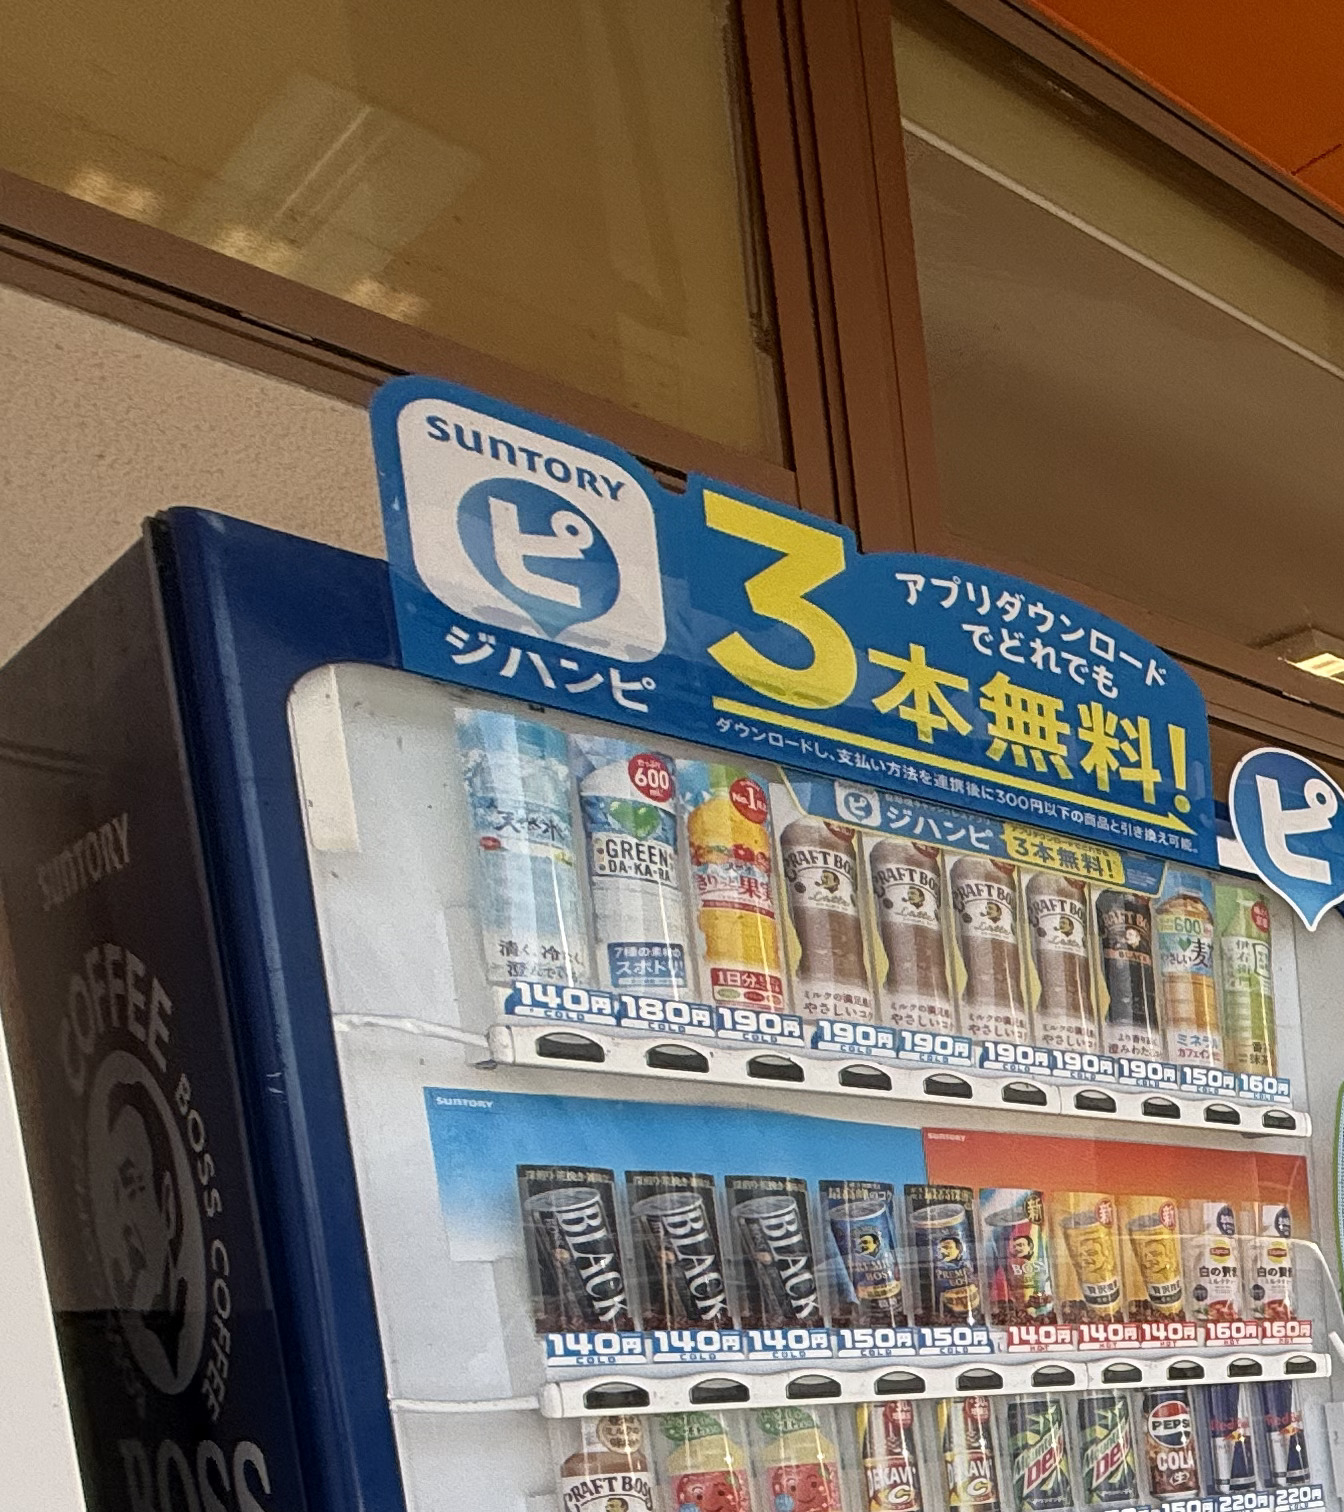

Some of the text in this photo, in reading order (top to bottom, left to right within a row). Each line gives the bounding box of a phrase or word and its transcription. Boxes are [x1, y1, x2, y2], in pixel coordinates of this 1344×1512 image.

[426, 415, 626, 501] SUNTORY
[894, 572, 1169, 687] アプリダウンロード
[445, 626, 656, 713] ジハンピ
[962, 622, 1118, 698] でどれでも
[634, 767, 670, 791] 600
[886, 806, 995, 850] ジハンピ
[1255, 774, 1338, 885] ピ
[605, 839, 669, 867] GREEN
[1013, 836, 1115, 879] 3本無料!
[1175, 917, 1200, 933] 600
[516, 981, 613, 1014] 140円
[622, 996, 712, 1026] 180円
[718, 1007, 800, 1037] 190円
[818, 1020, 894, 1047] 190円
[901, 1030, 970, 1056] 190円
[984, 1041, 1050, 1066] 190円
[1053, 1051, 1115, 1076] 190円
[1120, 1058, 1177, 1082] 190円
[1183, 1066, 1235, 1089] 150円
[1241, 1074, 1290, 1096] 160円
[559, 1202, 628, 1323] BLACK
[663, 1207, 728, 1321] BLACK
[760, 1212, 820, 1319] BLACK
[654, 1330, 742, 1352] 140円
[749, 1328, 828, 1350] 140円
[840, 1328, 912, 1349] 150円
[919, 1327, 989, 1348] 150円
[1009, 1325, 1071, 1344] 140円
[1080, 1325, 1137, 1342] 140円
[1142, 1323, 1195, 1340] 140円
[1207, 1322, 1257, 1339] 160円
[1264, 1321, 1311, 1337] 160円
[548, 1333, 643, 1356] 140円
[1157, 1451, 1194, 1471] COLA
[1219, 1493, 1268, 1512] 220円
[1276, 1487, 1322, 1504] 220円
